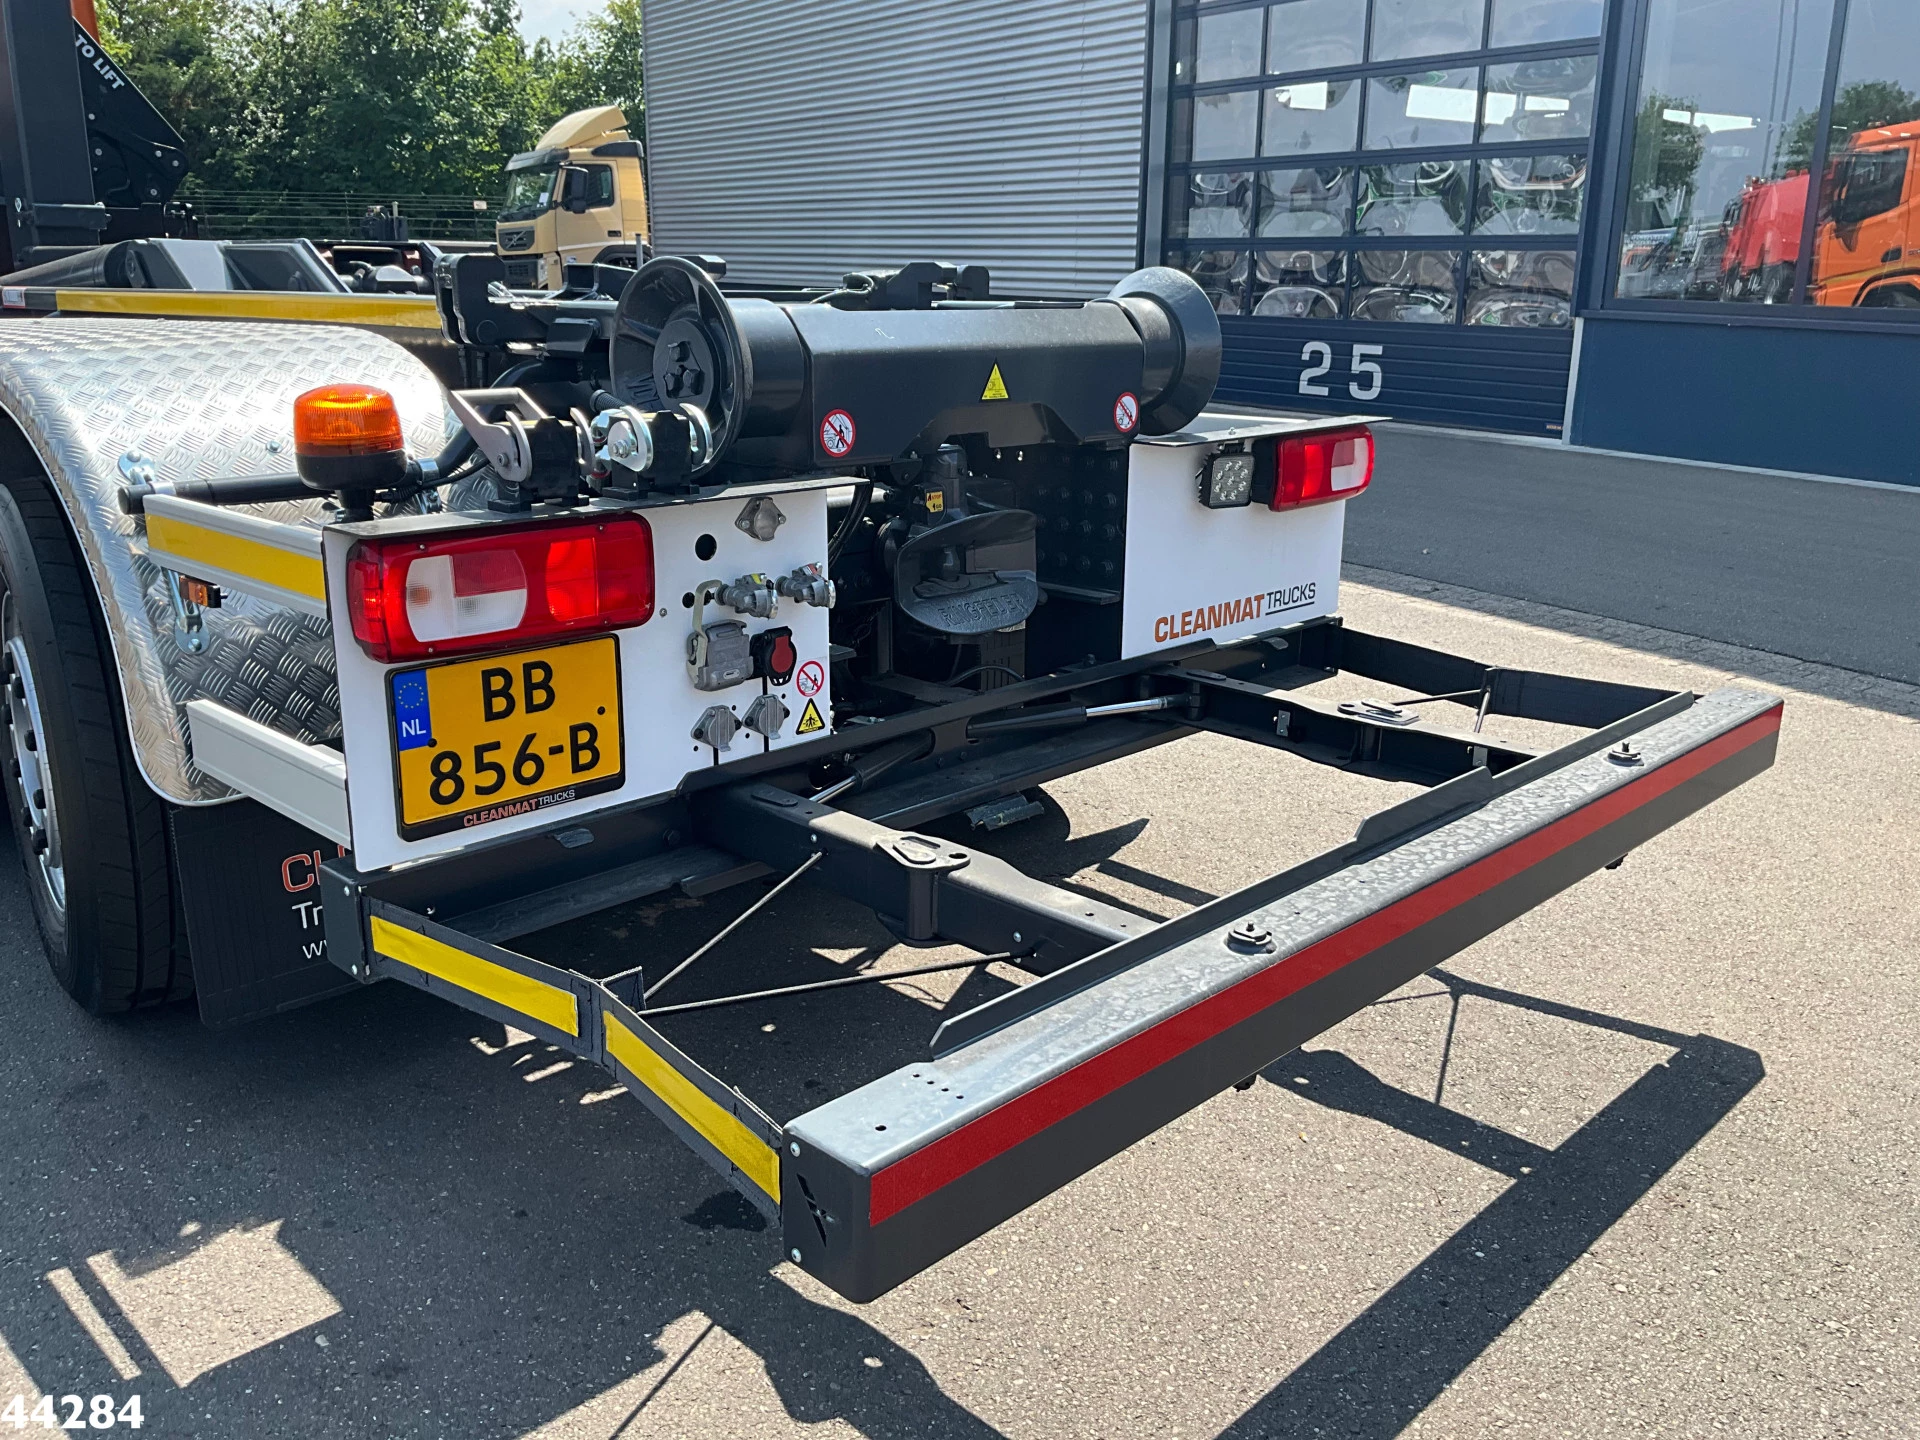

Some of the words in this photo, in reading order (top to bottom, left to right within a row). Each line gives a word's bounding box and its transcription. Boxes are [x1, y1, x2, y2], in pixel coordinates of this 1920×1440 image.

[75, 34, 95, 58] TO
[93, 57, 125, 89] LIFT
[1154, 593, 1265, 643] CLEANMAT
[1265, 582, 1317, 611] TRUCKS
[480, 660, 556, 722] BB
[402, 718, 427, 738] NL
[429, 721, 601, 806] 856-B
[463, 798, 539, 828] CLEANMAT
[537, 789, 576, 808] TRUCKS
